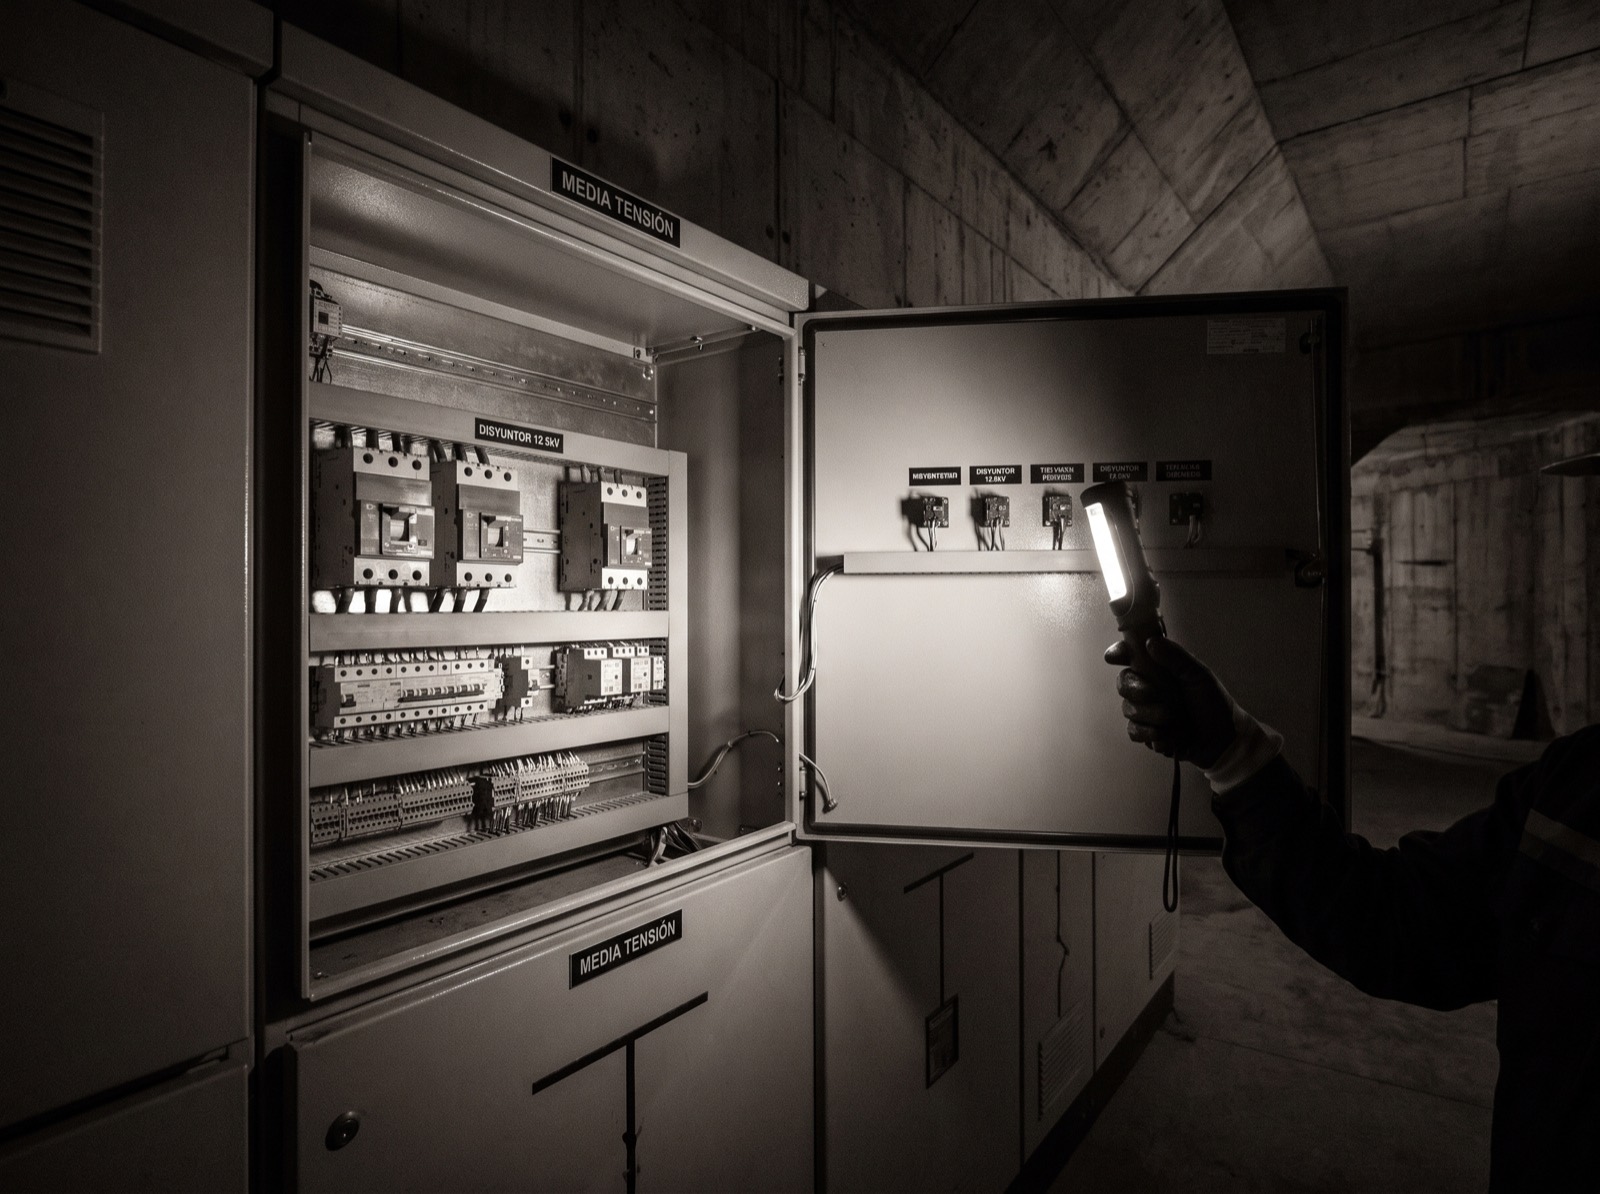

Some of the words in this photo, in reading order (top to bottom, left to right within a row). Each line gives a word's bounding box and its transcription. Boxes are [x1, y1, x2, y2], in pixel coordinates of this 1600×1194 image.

[562, 170, 612, 210] MEDIA
[615, 195, 674, 239] TENSIÓN
[479, 424, 532, 444] DISYUNTOR
[976, 467, 1015, 475] DISYUNTOR
[580, 943, 622, 976] MEDIA
[624, 919, 676, 955] TENSIÓN
